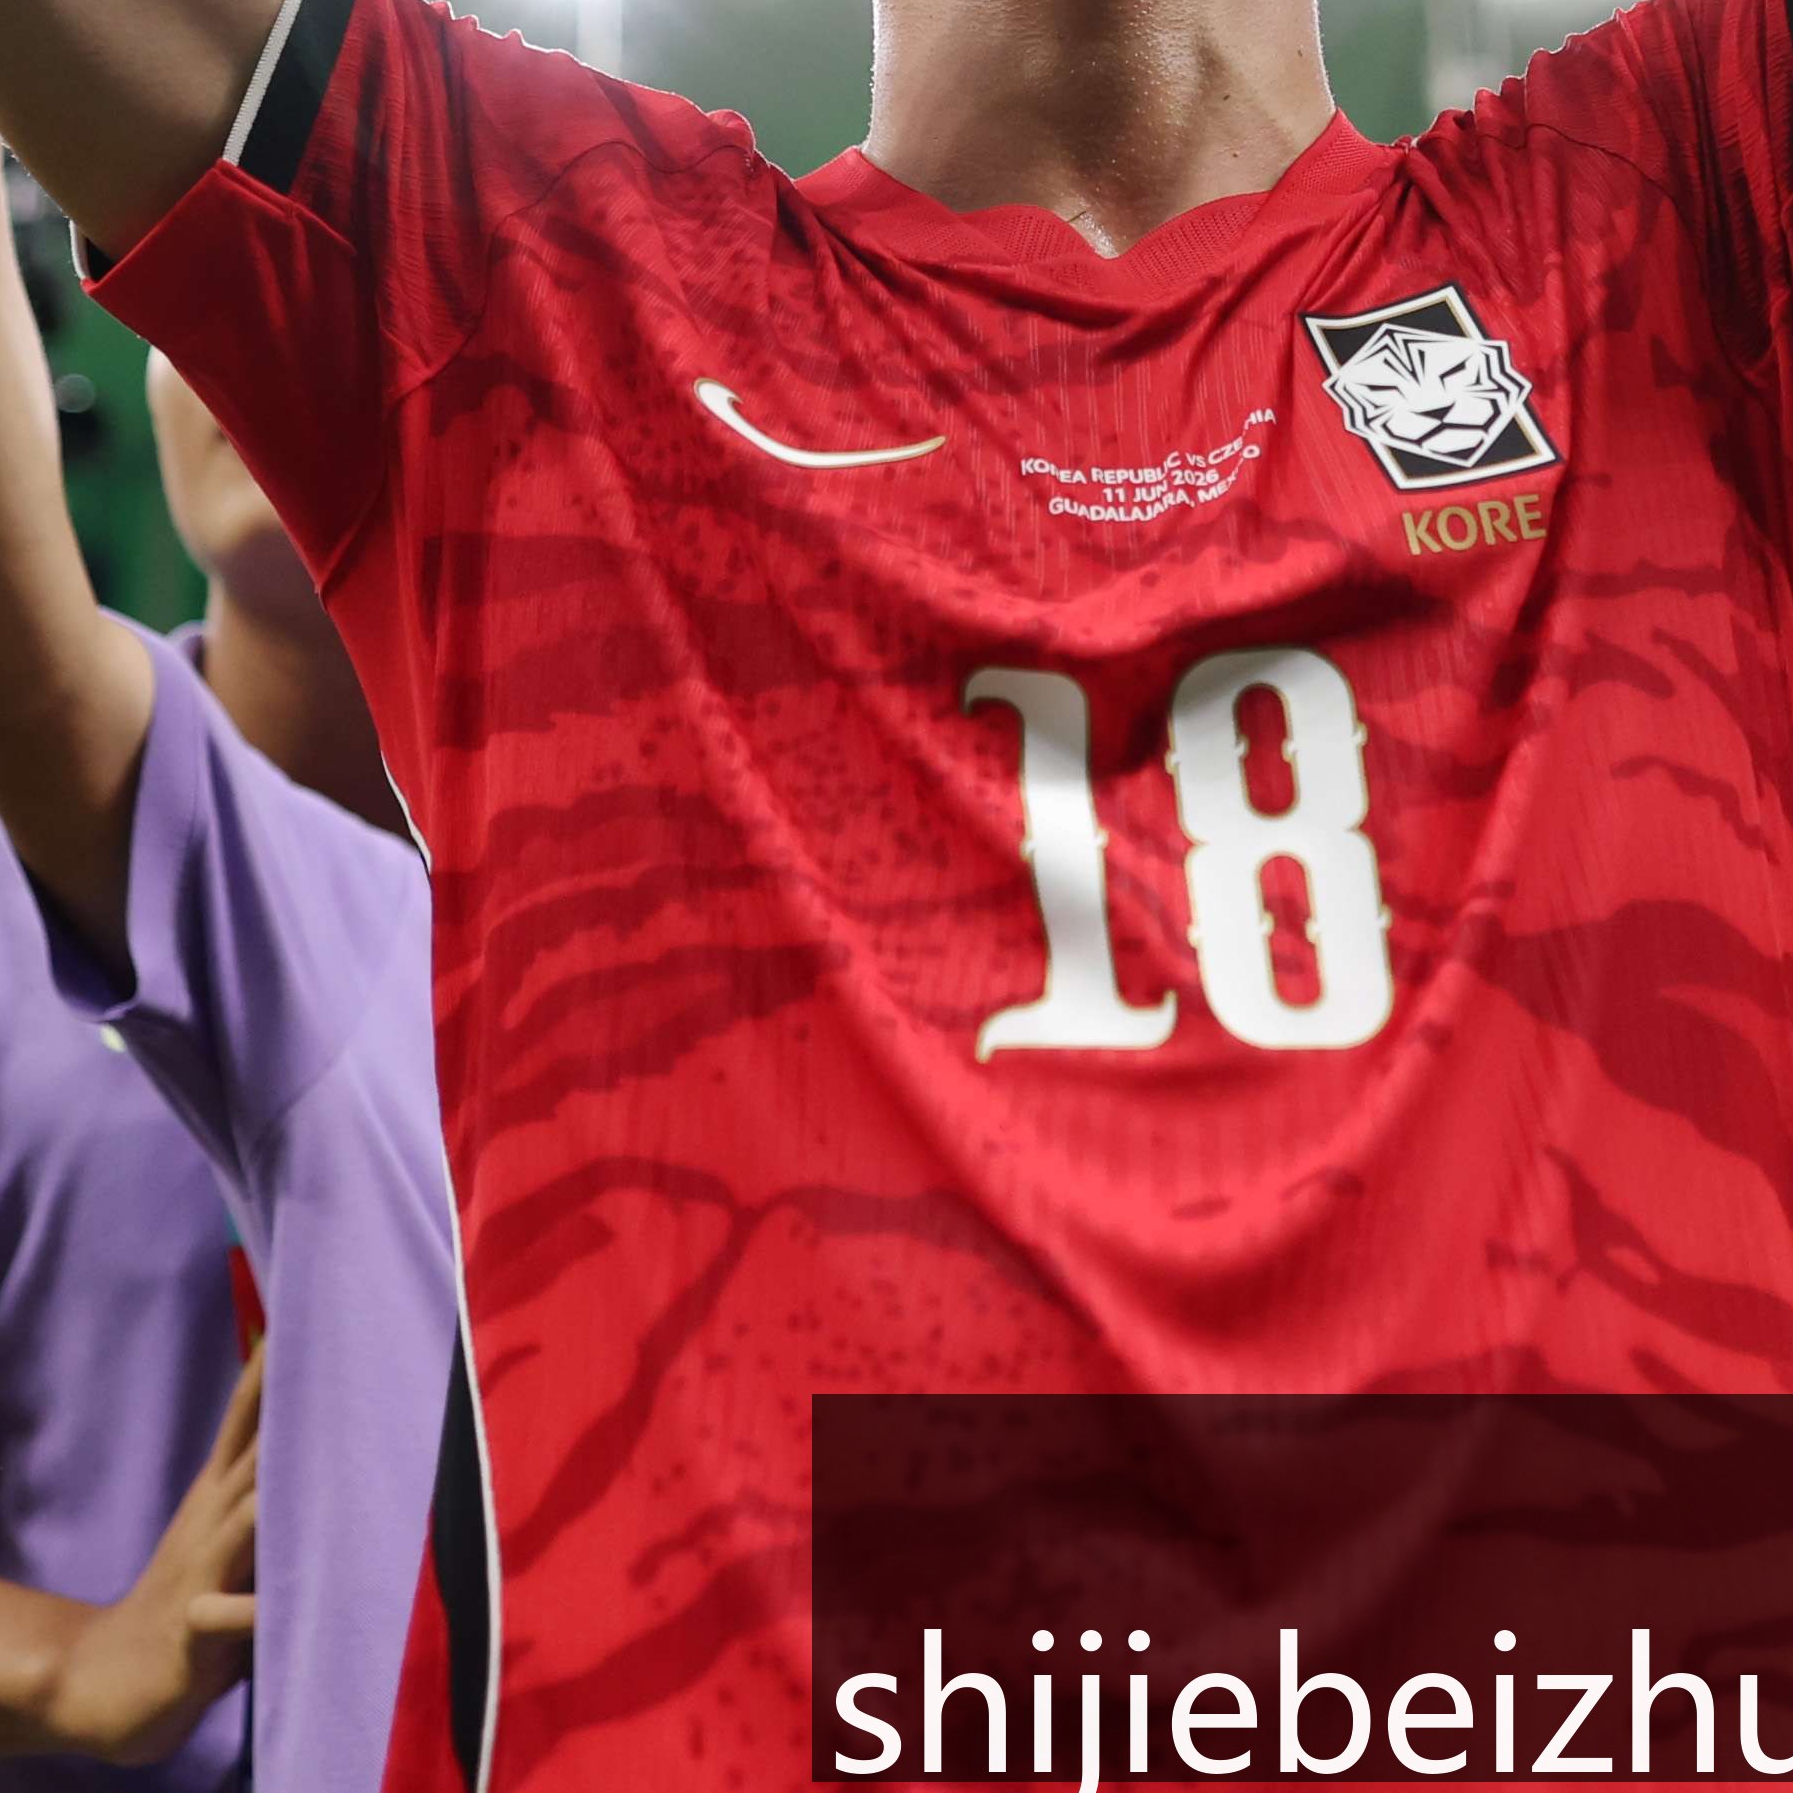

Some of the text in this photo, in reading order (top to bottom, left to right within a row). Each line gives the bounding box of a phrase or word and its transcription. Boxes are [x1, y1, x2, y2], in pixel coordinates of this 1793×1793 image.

[1020, 457, 1087, 484] KOREA
[1091, 451, 1182, 485] REPUBLIC
[1185, 452, 1207, 468] VS
[1102, 469, 1220, 503] 11 JUN 2026
[1048, 488, 1195, 522] GUADALAJARA,
[963, 644, 1396, 1064] 18
